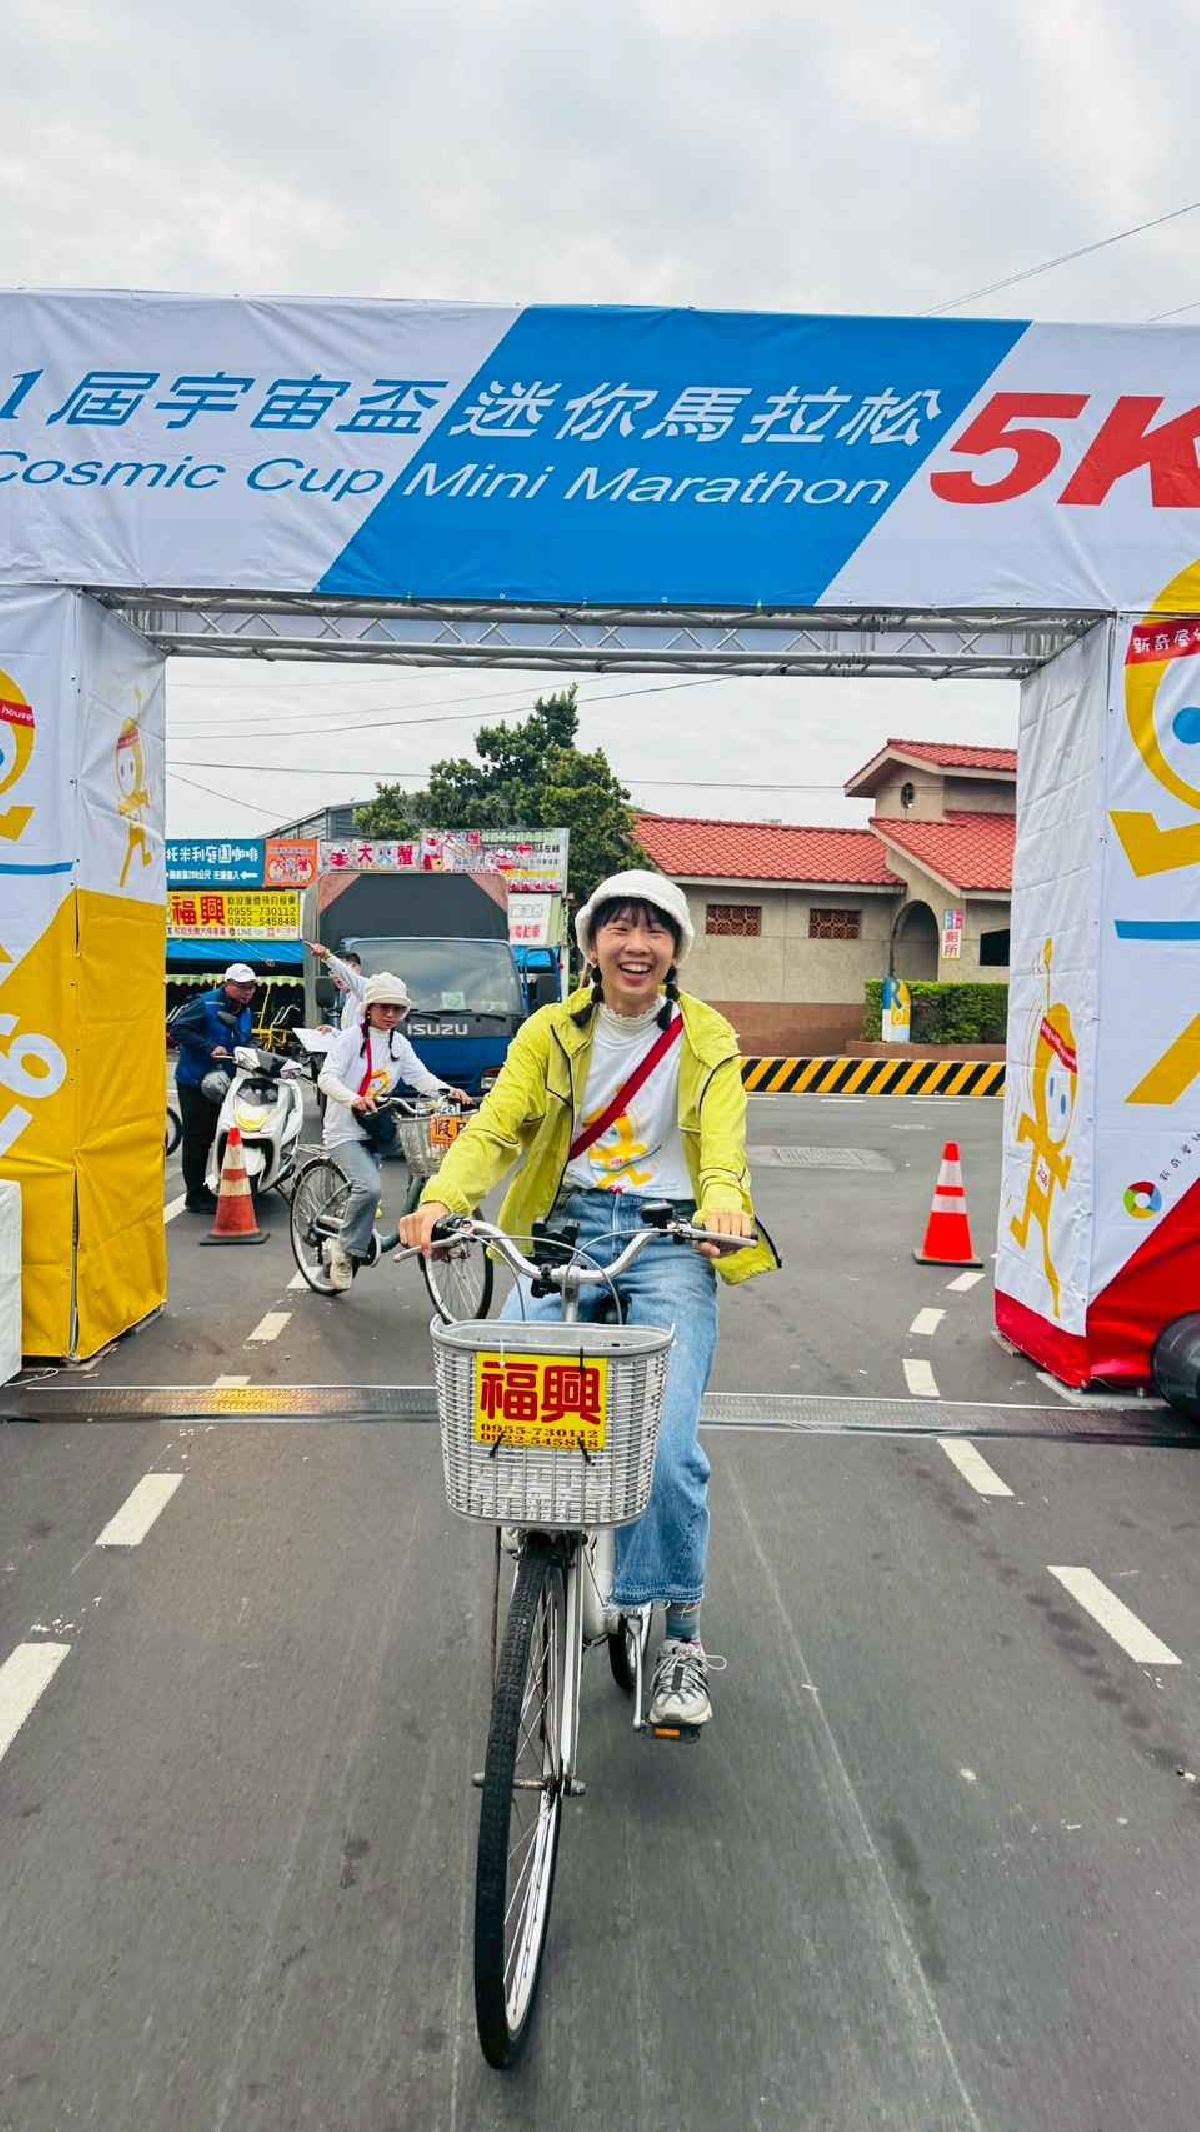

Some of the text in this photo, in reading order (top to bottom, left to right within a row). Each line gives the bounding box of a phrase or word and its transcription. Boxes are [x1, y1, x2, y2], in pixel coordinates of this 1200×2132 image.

[0, 450, 891, 505] Cosmic Cup Mini Marathon
[930, 392, 1200, 508] 5K
[171, 895, 226, 926] 福興
[407, 1023, 468, 1035] ISUZU
[480, 1361, 602, 1425] 福興
